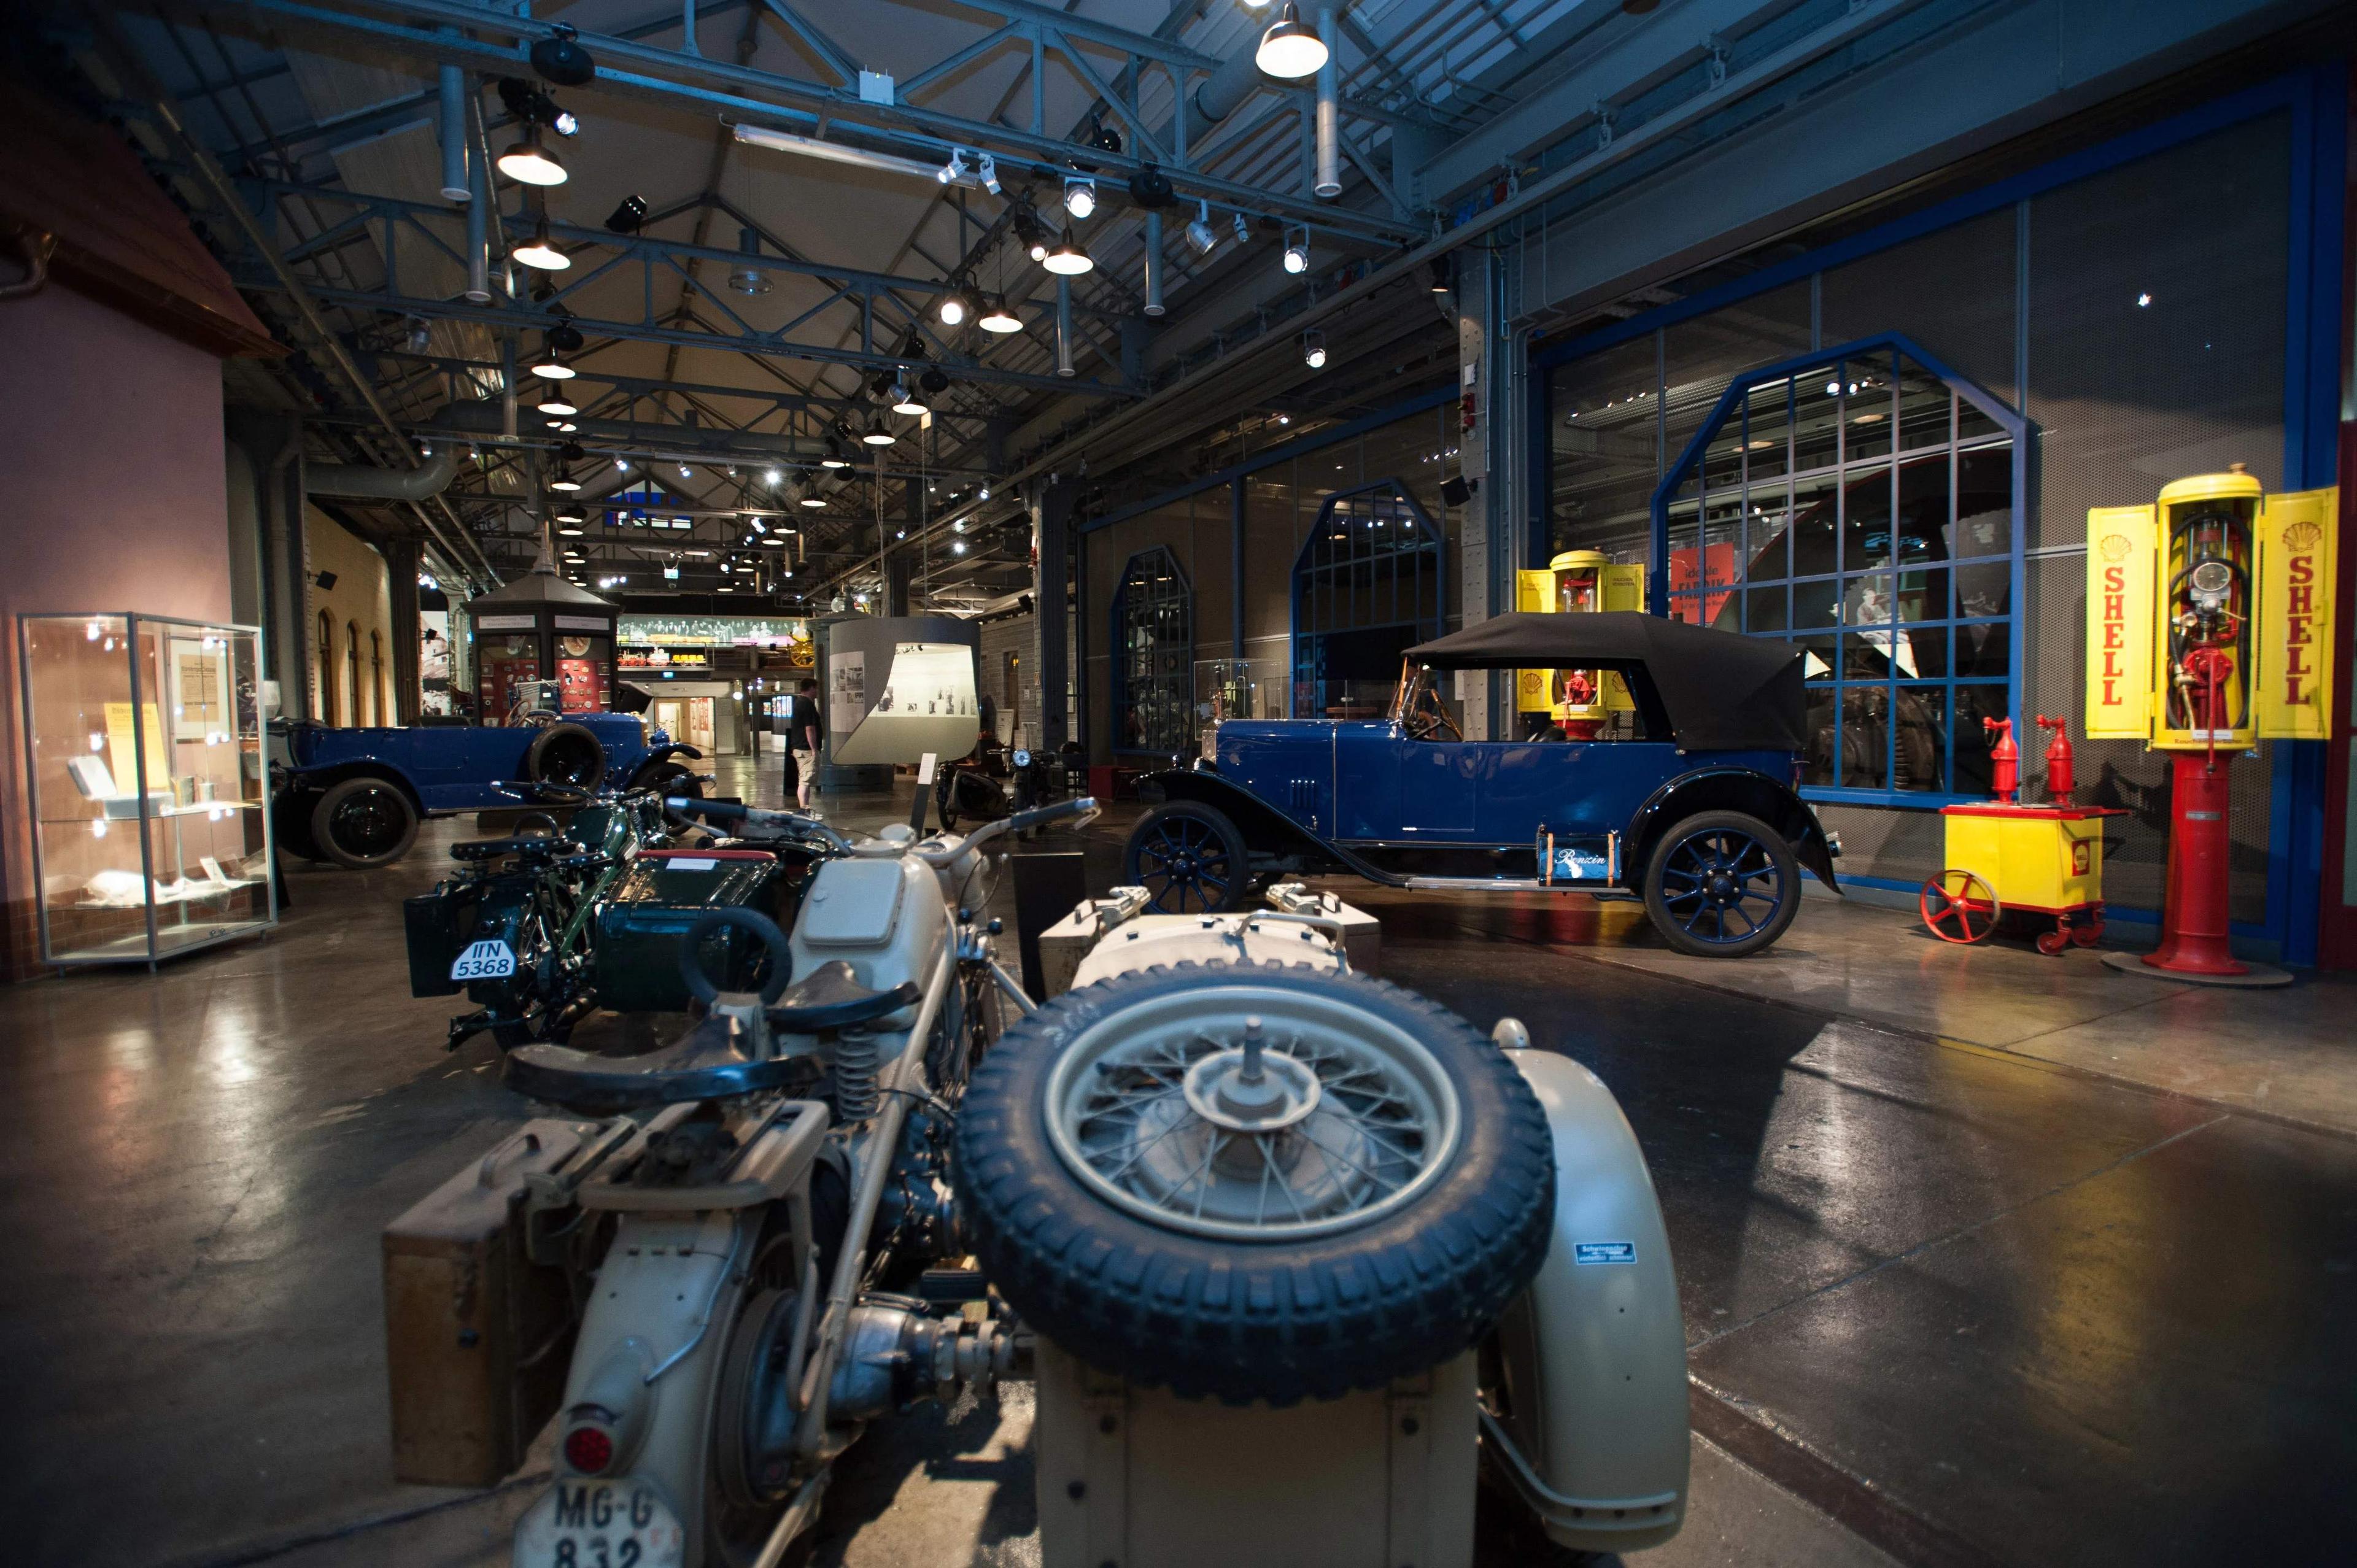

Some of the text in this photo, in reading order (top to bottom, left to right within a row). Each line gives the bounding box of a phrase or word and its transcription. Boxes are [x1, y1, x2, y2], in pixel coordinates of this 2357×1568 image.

[2102, 567, 2124, 706] SHELL
[2285, 556, 2313, 705] SHELL
[1555, 849, 1606, 864] Benzin
[457, 959, 509, 977] 5368
